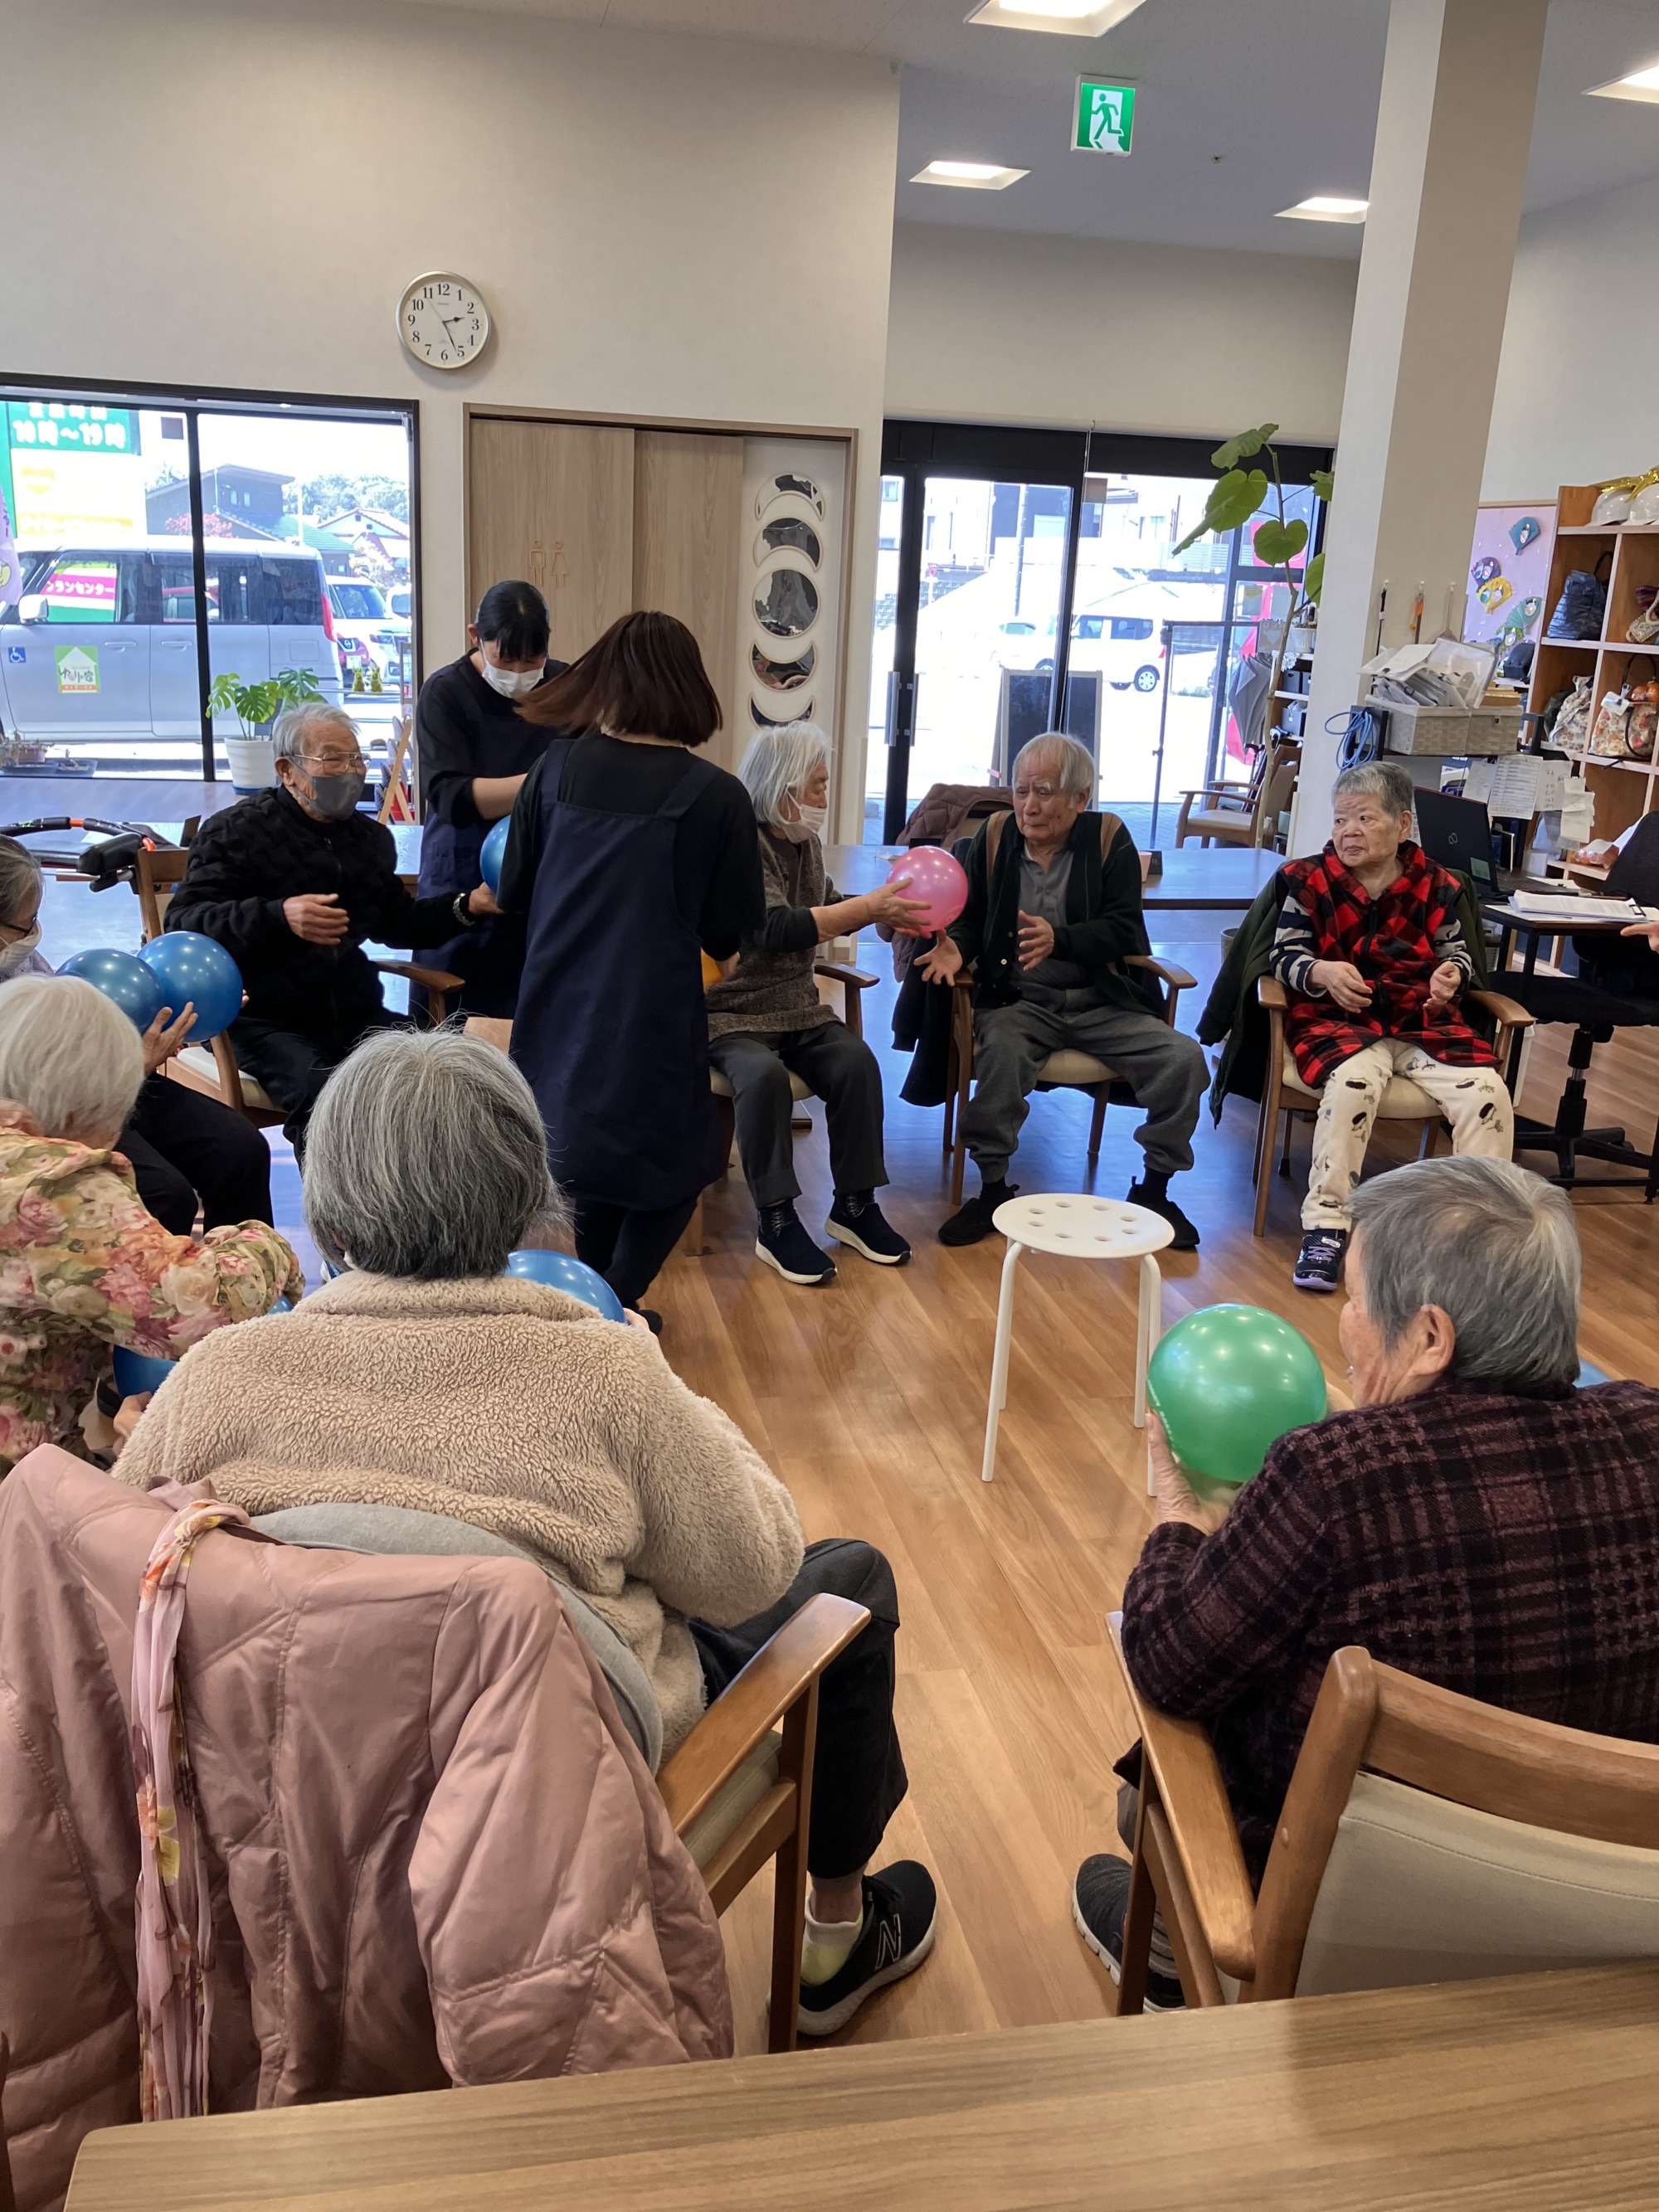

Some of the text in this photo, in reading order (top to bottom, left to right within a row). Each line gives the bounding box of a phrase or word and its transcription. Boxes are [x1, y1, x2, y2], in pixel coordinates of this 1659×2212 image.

[423, 287, 433, 299] 11
[437, 283, 450, 296] 12
[457, 289, 462, 301] 1
[411, 299, 424, 311] 10
[467, 302, 474, 314] 2
[407, 314, 416, 326] 9
[471, 318, 479, 330] 3
[412, 331, 421, 343] 8
[467, 334, 474, 346] 4
[425, 344, 432, 356] 7
[440, 349, 448, 361] 6
[457, 346, 465, 357] 5
[875, 1913, 902, 1970] N
